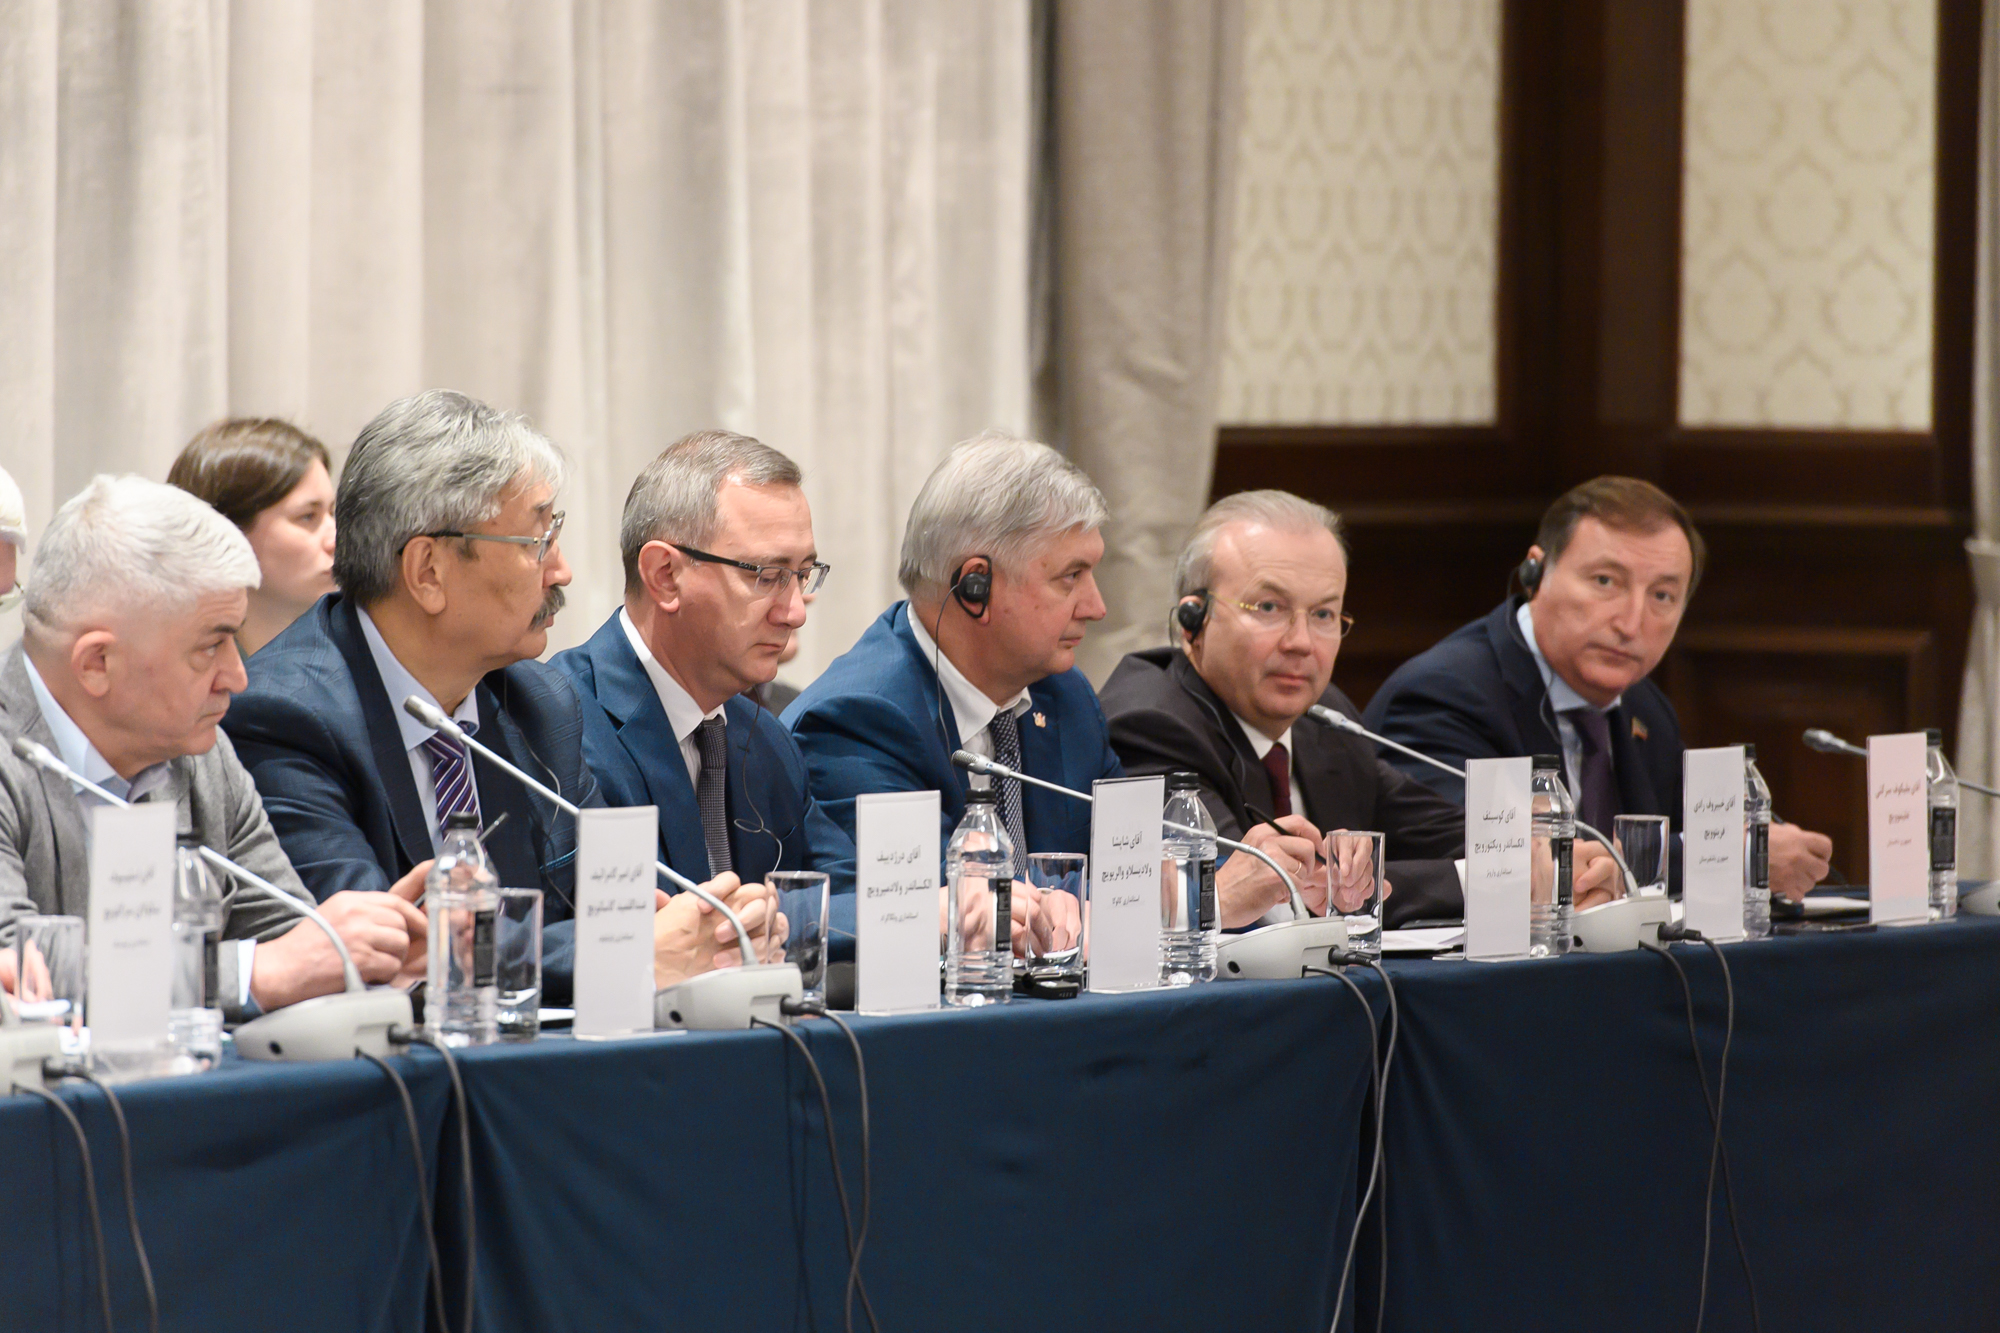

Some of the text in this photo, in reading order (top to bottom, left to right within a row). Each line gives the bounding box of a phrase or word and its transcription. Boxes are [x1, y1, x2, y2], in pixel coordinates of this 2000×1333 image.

[1504, 807, 1516, 824] آقای
[1130, 831, 1142, 849] آقای
[907, 845, 921, 864] آقای
